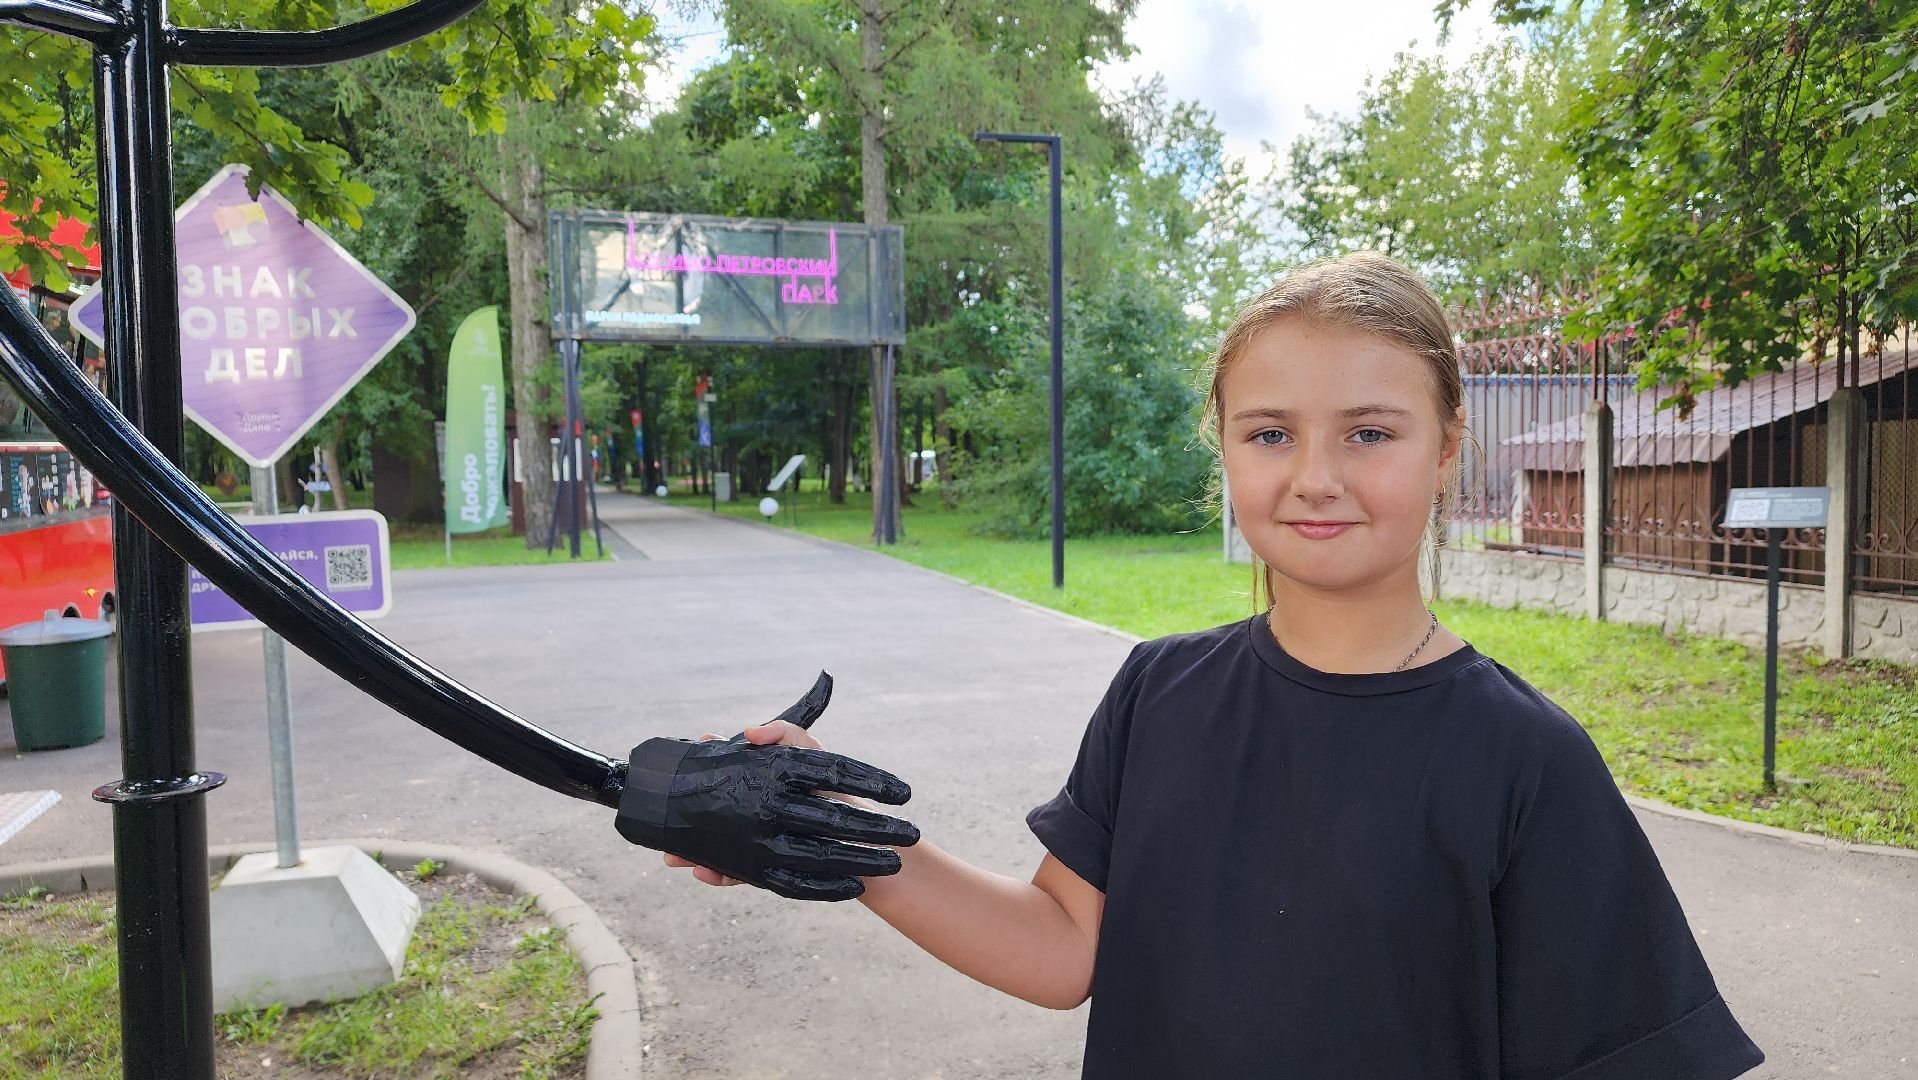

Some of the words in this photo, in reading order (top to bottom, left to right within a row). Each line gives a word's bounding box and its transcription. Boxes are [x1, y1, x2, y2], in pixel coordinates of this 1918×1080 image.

[182, 265, 316, 298] ЗНАК
[782, 275, 838, 304] ПАРК
[181, 306, 358, 340] ОБРЫХ
[205, 348, 303, 384] ДЕЛ
[460, 453, 481, 523] Добро
